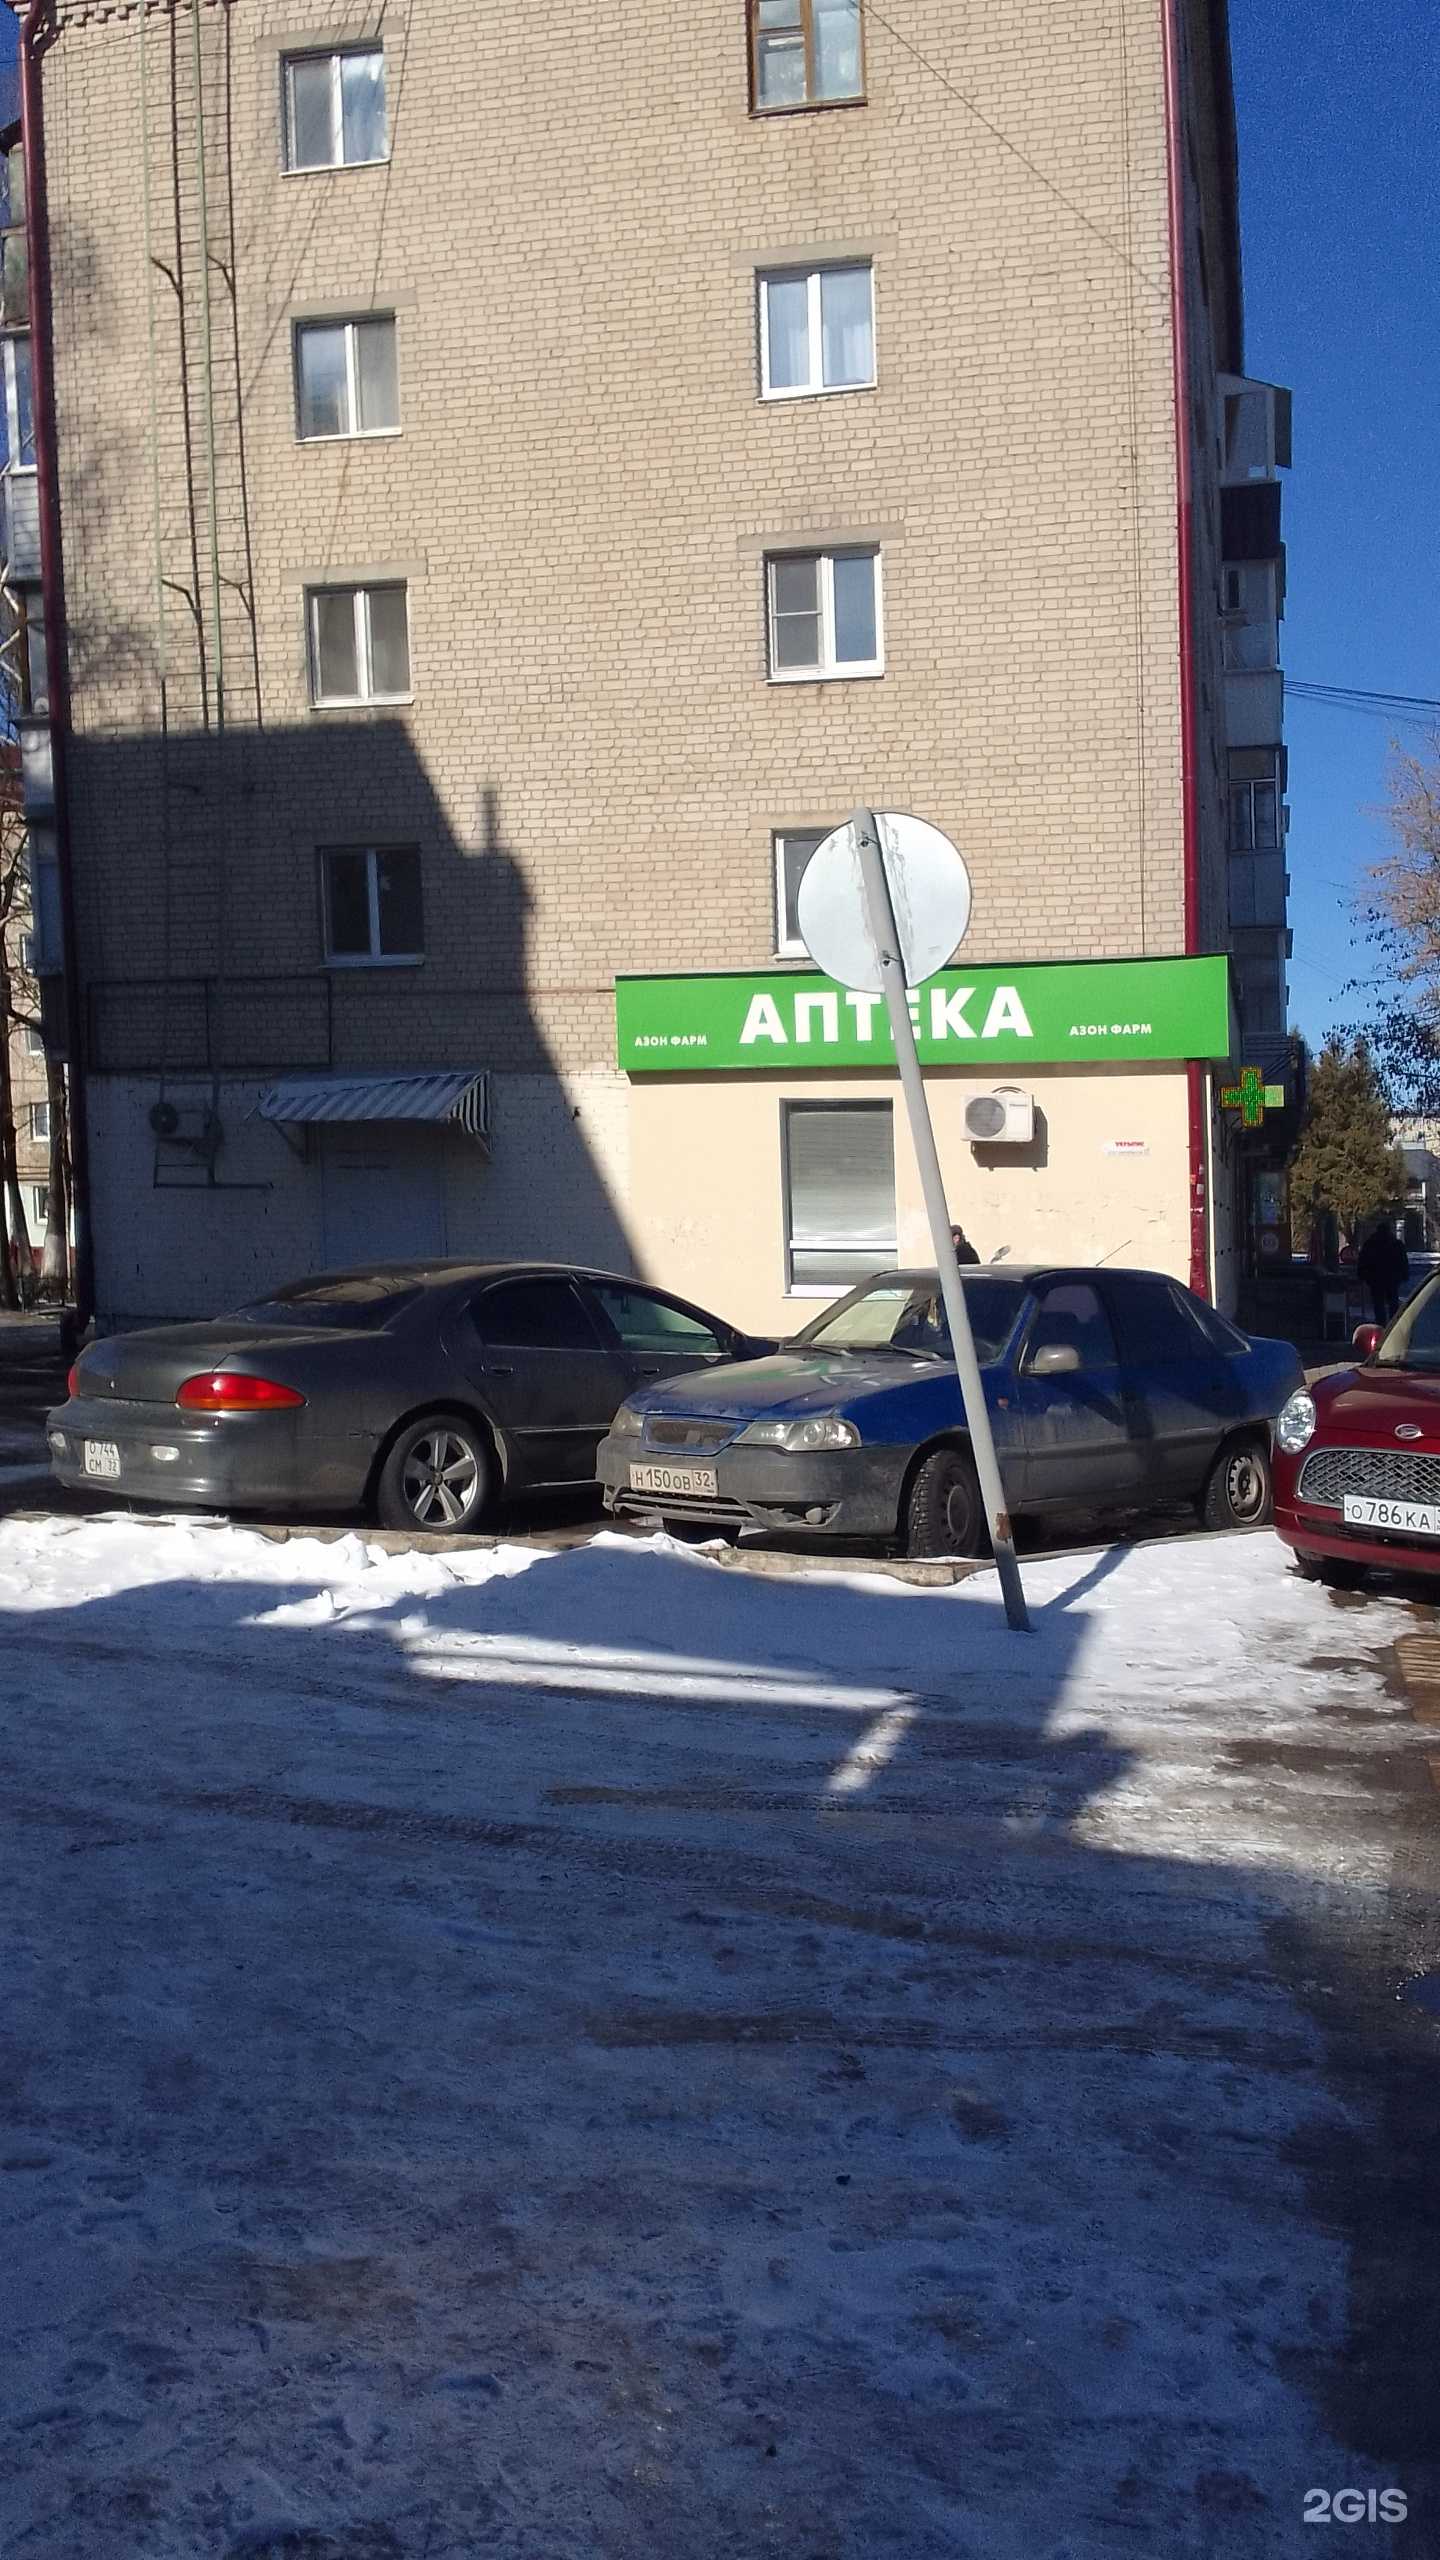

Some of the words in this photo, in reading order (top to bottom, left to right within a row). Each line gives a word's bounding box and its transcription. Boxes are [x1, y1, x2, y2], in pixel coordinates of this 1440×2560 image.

[1069, 1025, 1108, 1036] АЗОН
[1110, 1023, 1152, 1034] ФАРМ
[634, 1036, 668, 1047] АЗОН
[670, 1035, 708, 1046] ФАРМ
